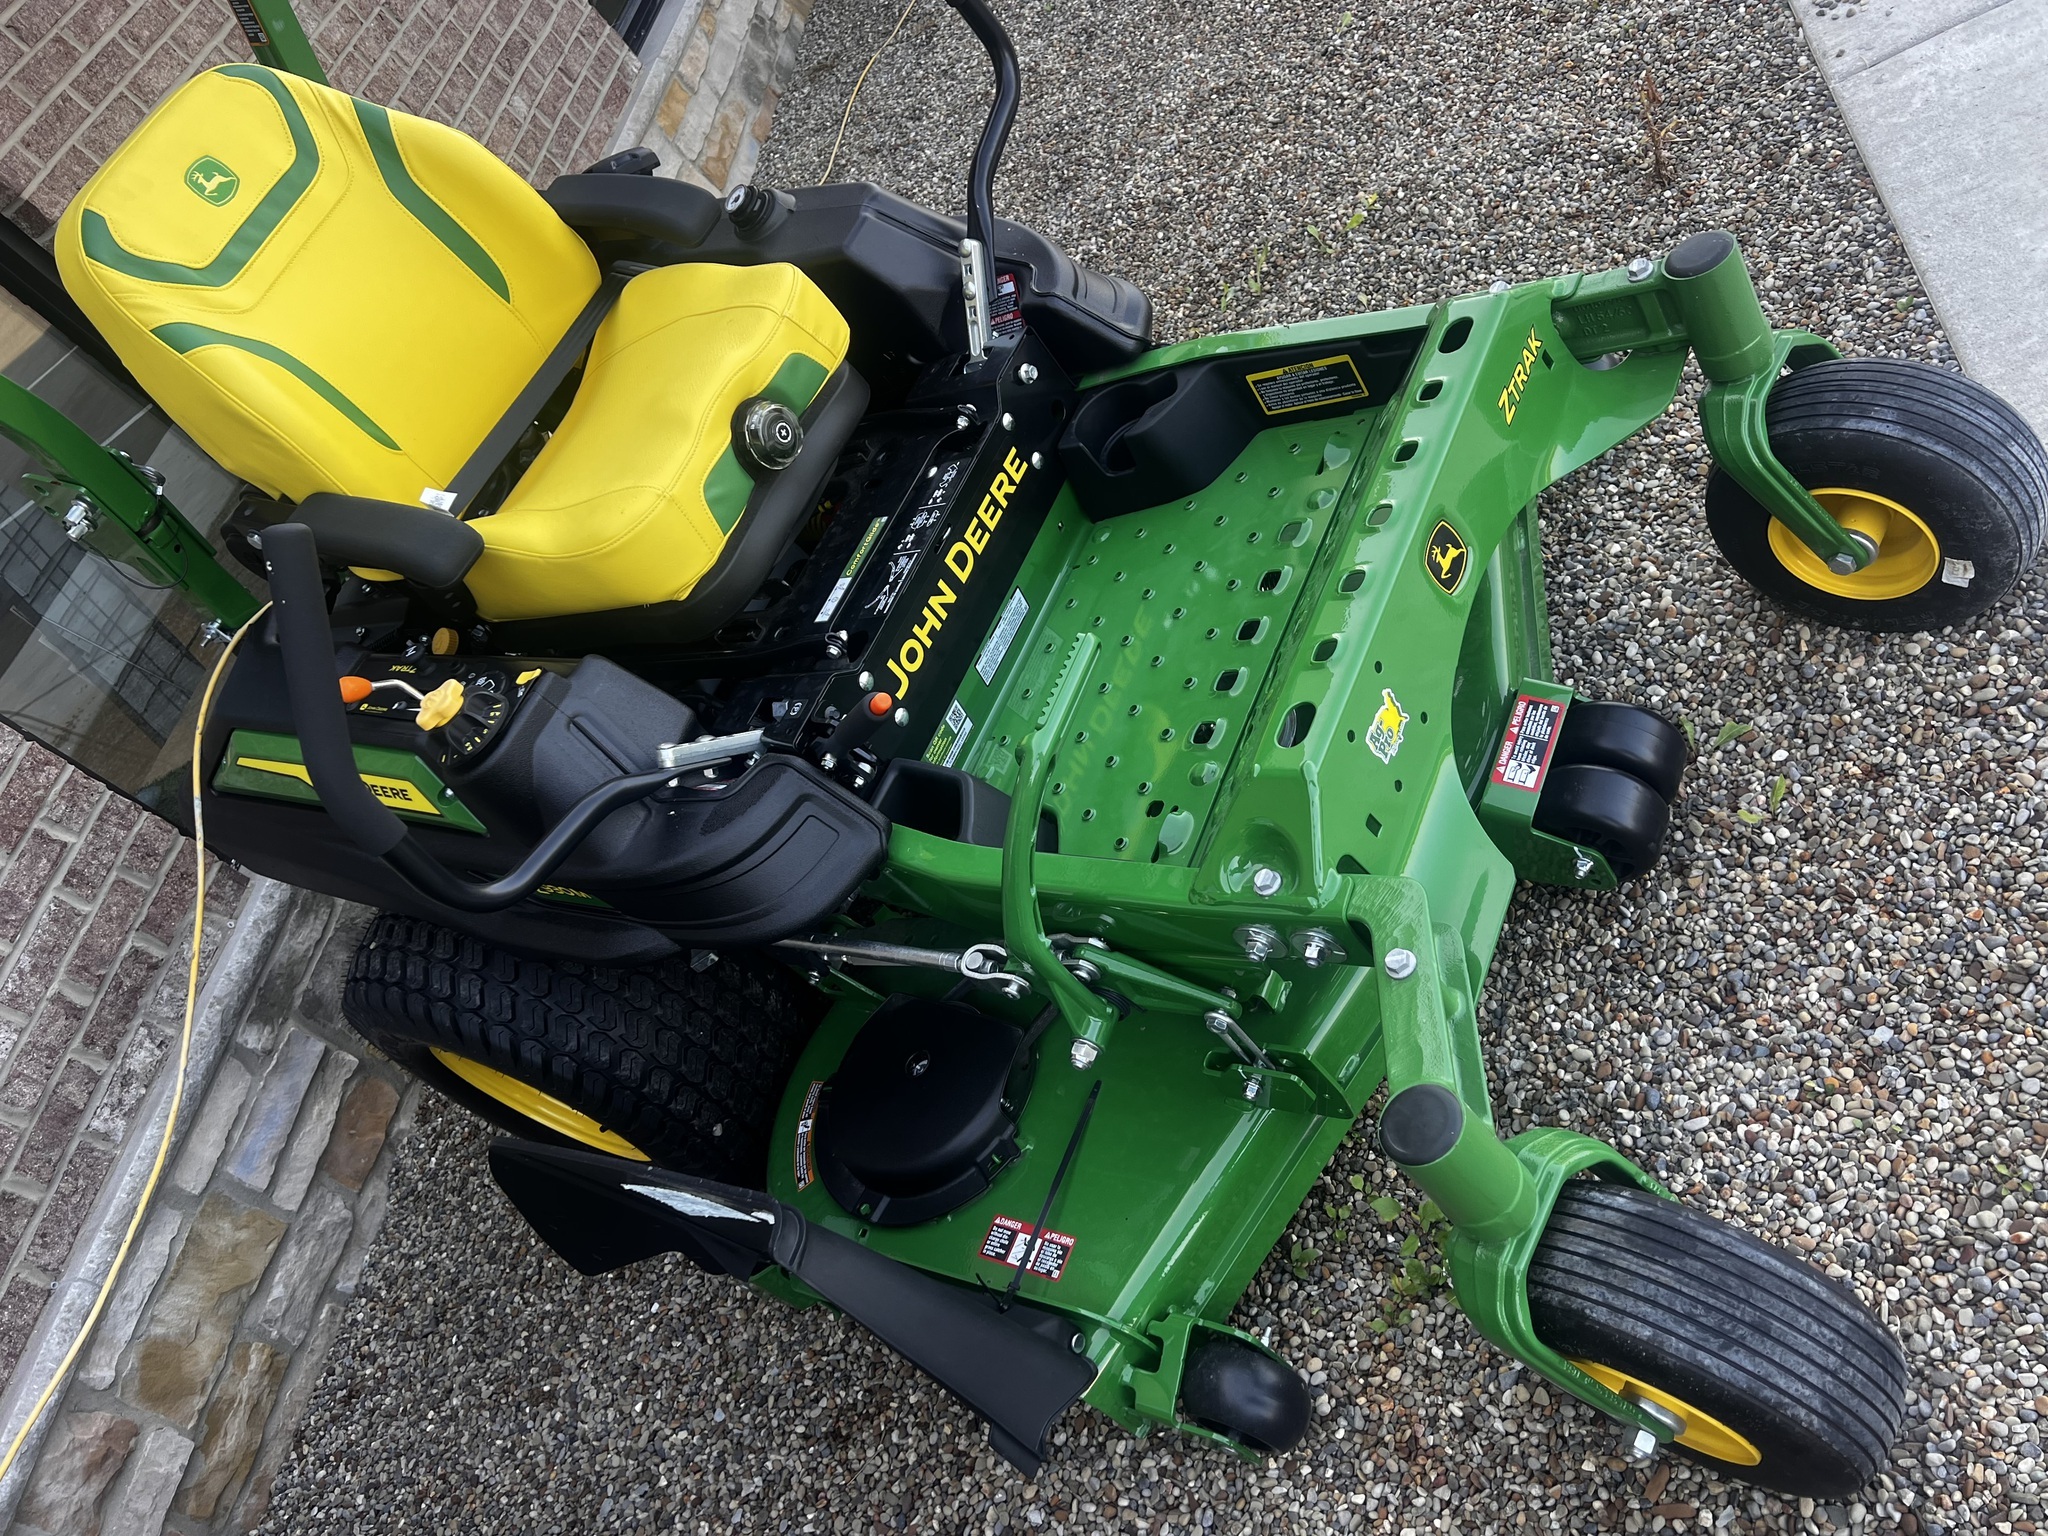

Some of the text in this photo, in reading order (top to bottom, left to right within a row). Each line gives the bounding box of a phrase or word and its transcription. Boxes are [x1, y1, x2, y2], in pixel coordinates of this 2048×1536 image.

[995, 312, 1013, 322] PELIGRO
[1496, 325, 1544, 427] ZTRAK
[886, 578, 957, 700] JOHN
[944, 446, 1028, 584] DEERE
[1512, 701, 1526, 725] PELIGRO
[1369, 718, 1386, 748] Ag-
[1377, 726, 1395, 757] Pro
[1499, 741, 1513, 765] DANGER
[1000, 1217, 1022, 1230] DANGER
[1049, 1233, 1074, 1246] PELIGRO
